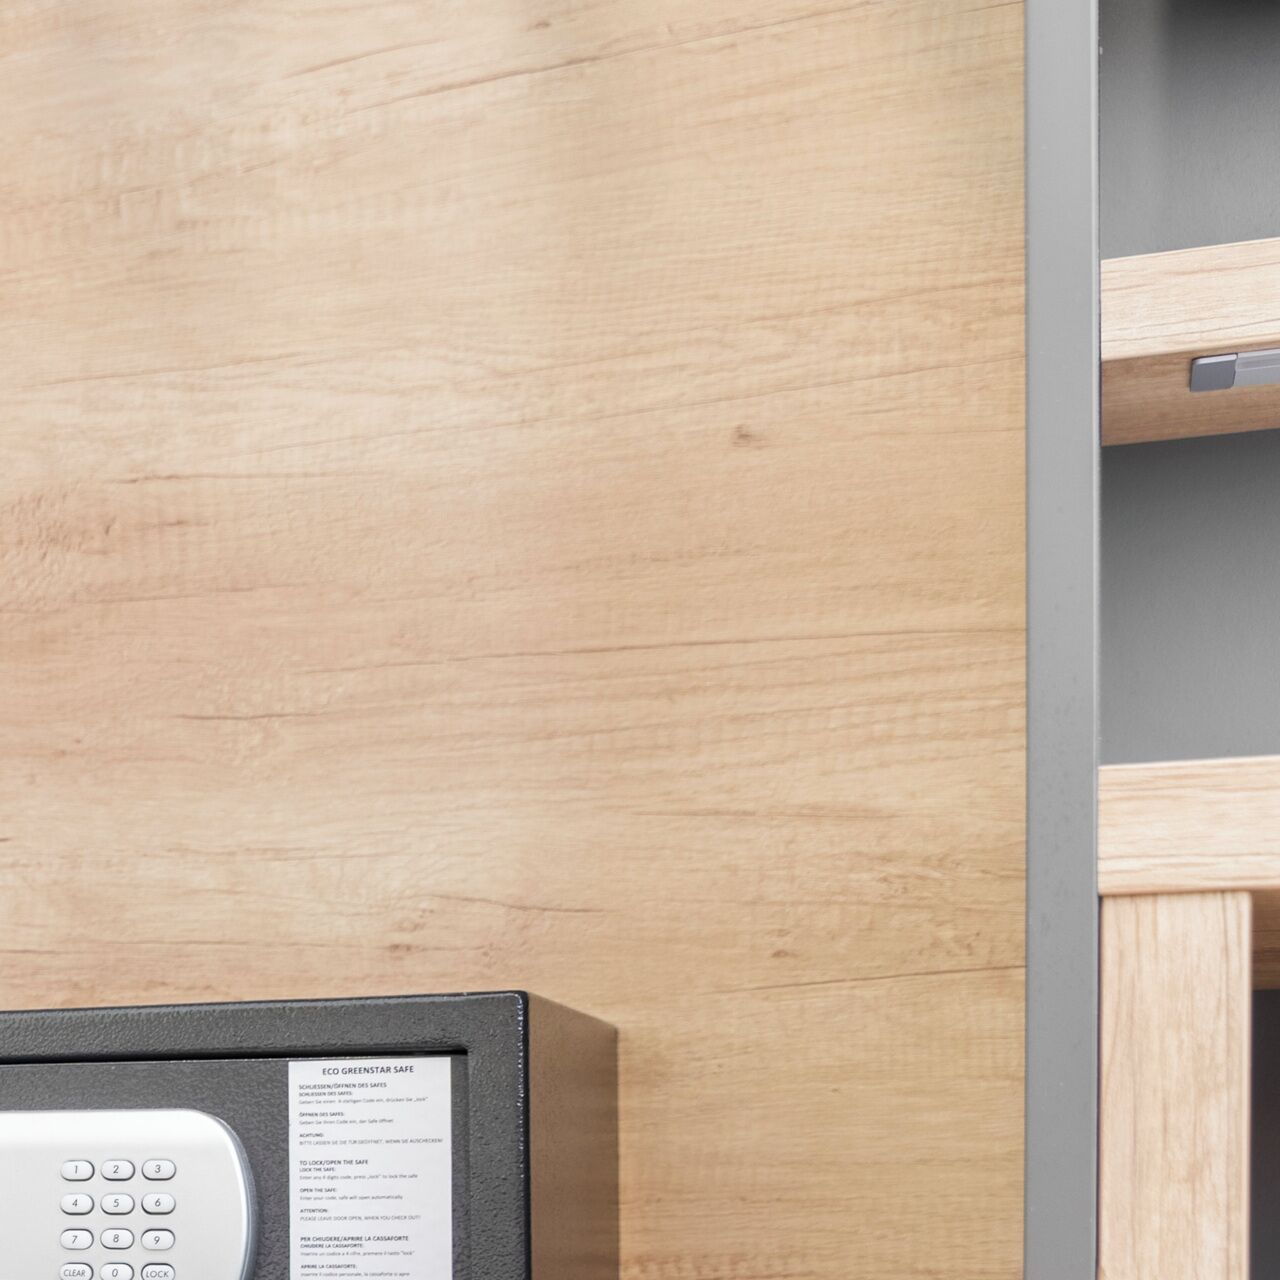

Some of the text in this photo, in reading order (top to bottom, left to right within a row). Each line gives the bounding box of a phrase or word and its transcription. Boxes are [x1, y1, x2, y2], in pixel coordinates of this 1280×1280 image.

[322, 1065, 414, 1076] ECO GREENSTAR SAFE
[74, 1165, 79, 1174] 1
[113, 1165, 119, 1174] 2
[154, 1164, 161, 1174] 3
[72, 1199, 78, 1208] 4
[113, 1199, 119, 1208] 5
[155, 1198, 161, 1207] 6
[71, 1235, 78, 1244] 7
[113, 1234, 119, 1243] 8
[154, 1236, 160, 1245] 9
[63, 1269, 86, 1278] CLEAR
[145, 1270, 169, 1279] LOCK
